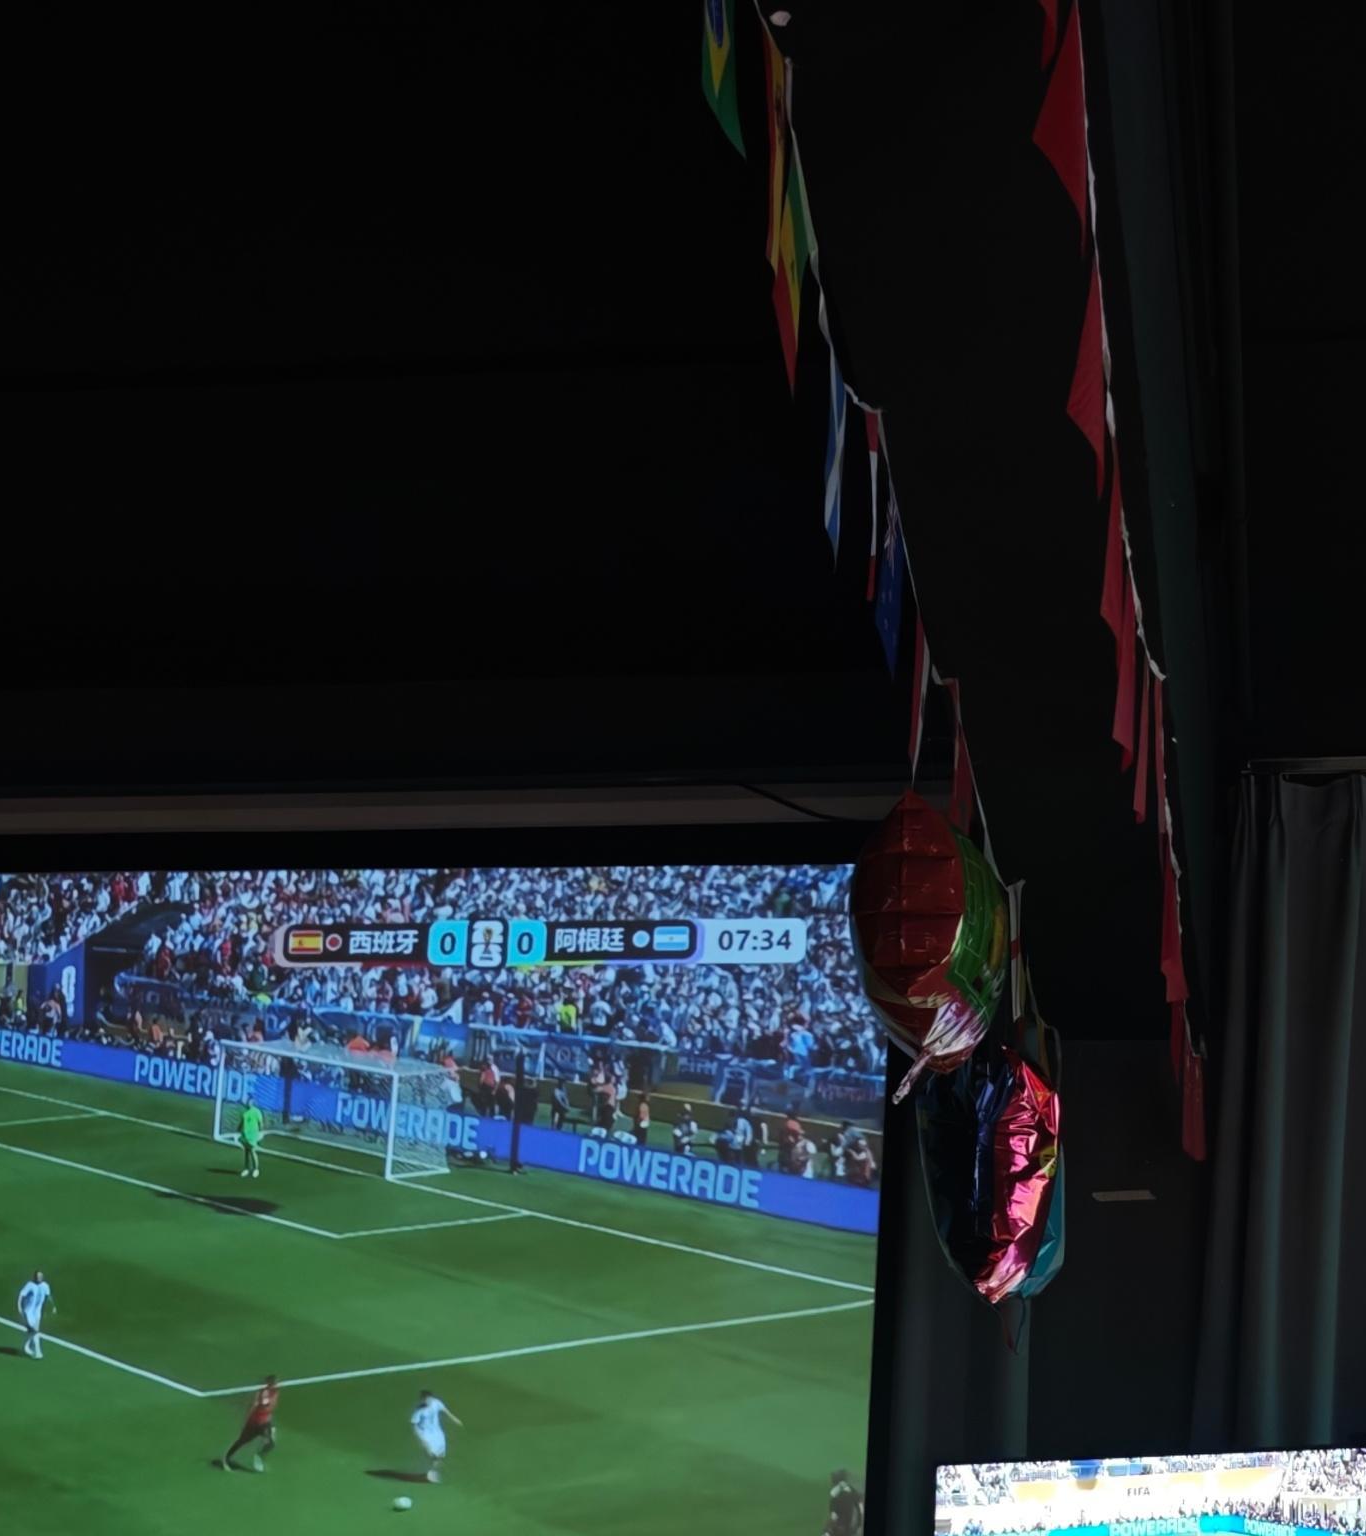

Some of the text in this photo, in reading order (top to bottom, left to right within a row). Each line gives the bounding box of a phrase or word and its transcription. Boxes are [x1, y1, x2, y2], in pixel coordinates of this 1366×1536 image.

[348, 930, 419, 955] 西班牙
[439, 932, 457, 955] 0
[517, 931, 534, 955] 0
[554, 927, 625, 953] 阿根廷
[718, 930, 792, 951] 07:34
[578, 1138, 763, 1208] POWERADE
[1127, 1487, 1150, 1497] FIFA
